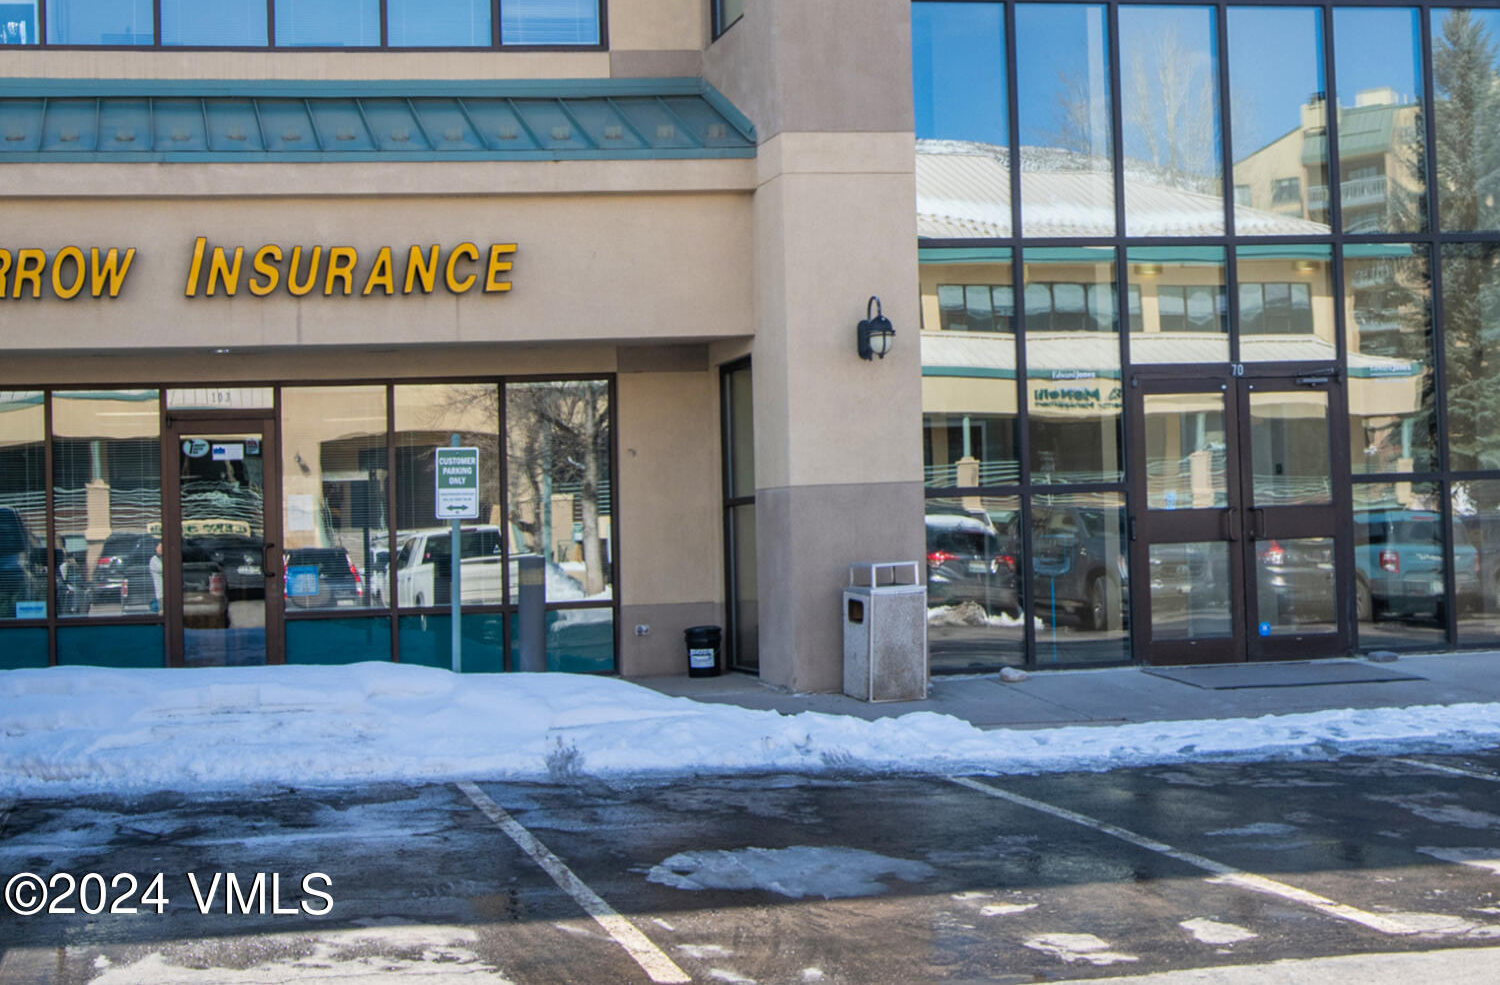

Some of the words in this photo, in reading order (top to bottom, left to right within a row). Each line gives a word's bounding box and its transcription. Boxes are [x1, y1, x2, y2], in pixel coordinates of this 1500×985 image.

[185, 236, 518, 297] INSURANCE
[1231, 364, 1244, 376] 70
[439, 456, 475, 465] CUSTOMER
[442, 467, 472, 475] PARKING
[448, 477, 466, 485] ONLY
